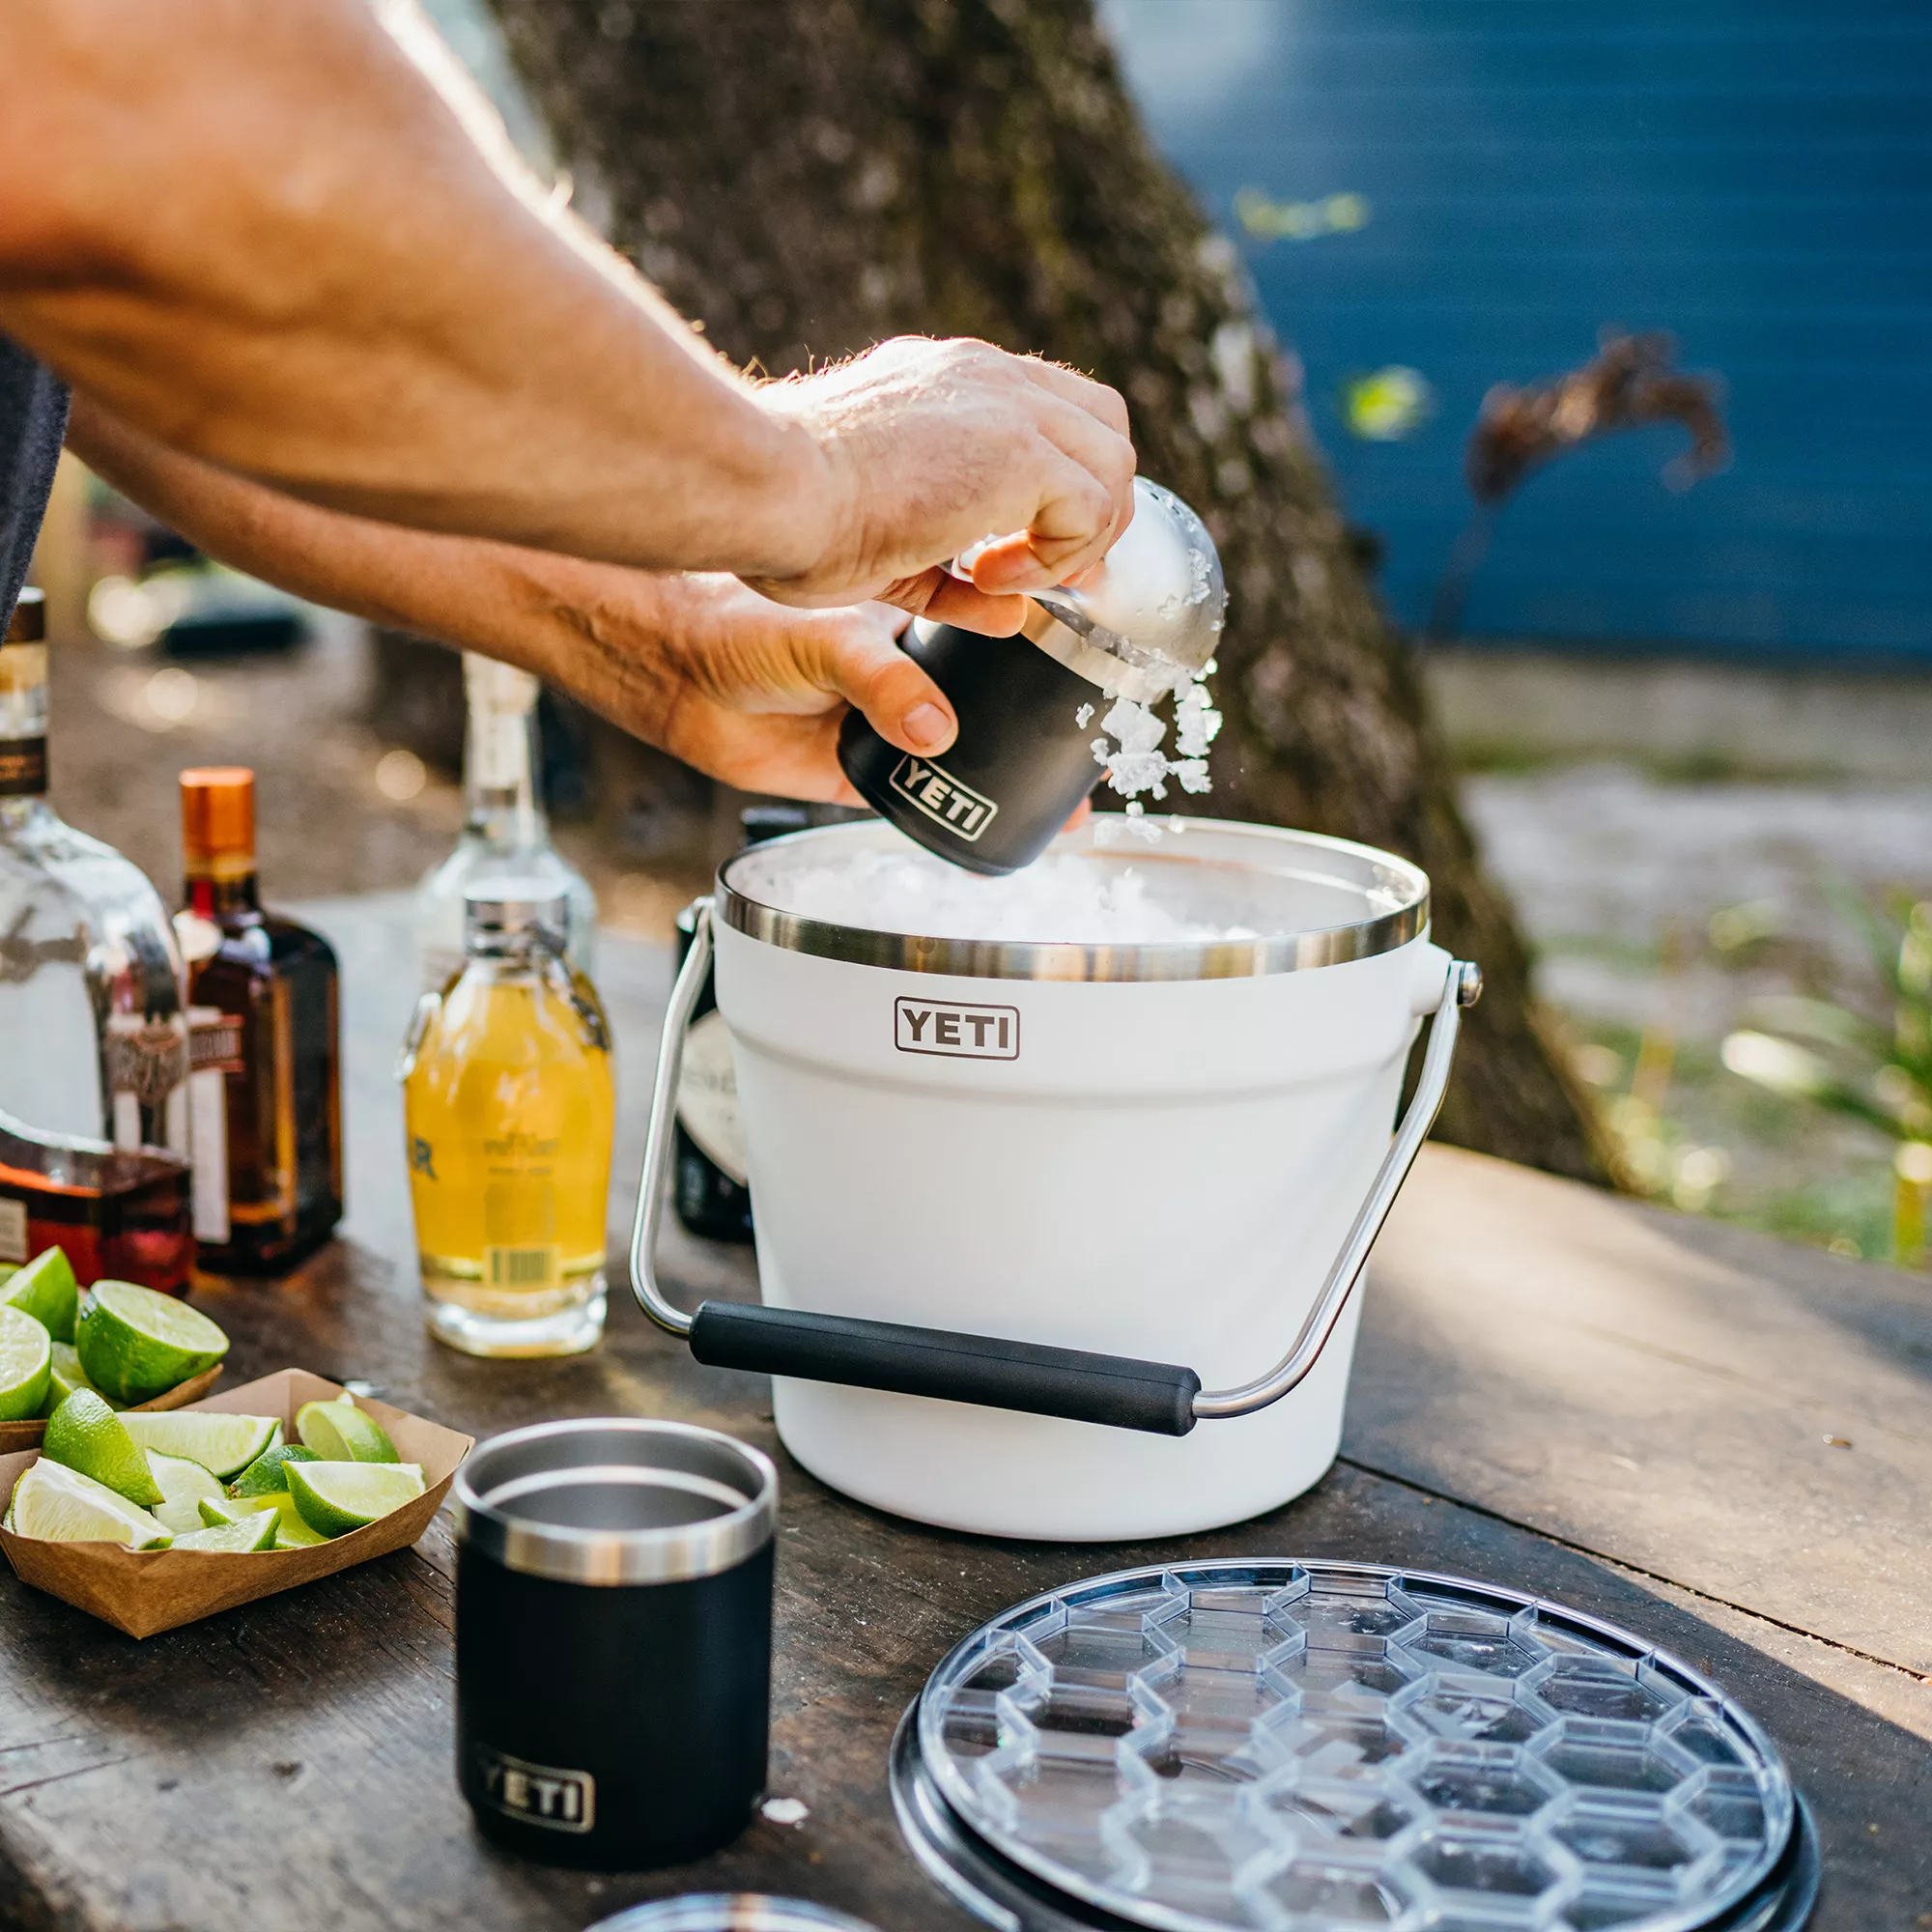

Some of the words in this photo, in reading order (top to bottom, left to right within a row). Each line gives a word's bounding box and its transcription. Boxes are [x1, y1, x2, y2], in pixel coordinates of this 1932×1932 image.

[904, 758, 985, 831] YETI
[901, 1008, 1009, 1049] YETI
[481, 1757, 579, 1820] YETI
